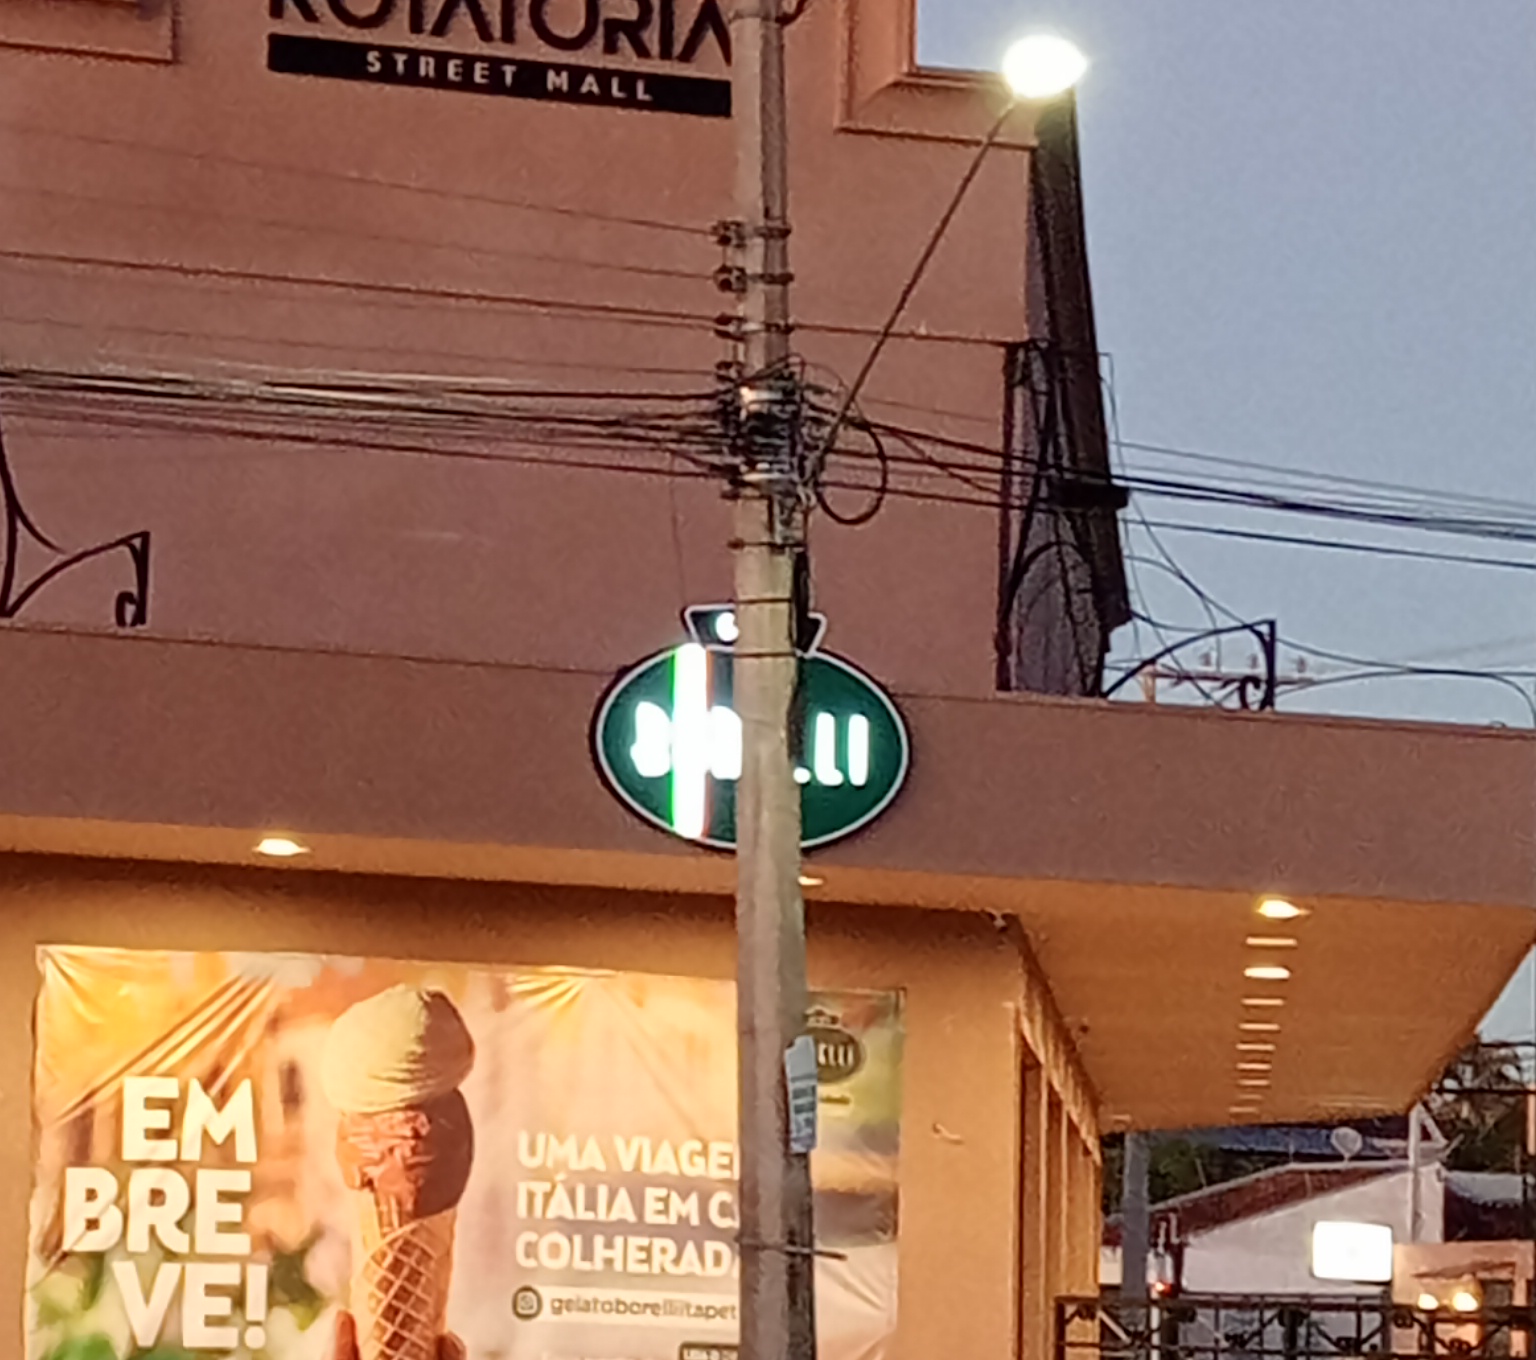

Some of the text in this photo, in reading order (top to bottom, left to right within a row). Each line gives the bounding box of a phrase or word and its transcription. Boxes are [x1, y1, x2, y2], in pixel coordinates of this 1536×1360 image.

[365, 50, 654, 102] STREET MALL
[120, 1075, 258, 1163] EM
[517, 1130, 607, 1172] UMA
[61, 1166, 252, 1256] BRE
[516, 1172, 638, 1223] ITÁLIA
[643, 1186, 701, 1227] EM
[515, 1230, 740, 1279] COLHERAD
[111, 1260, 269, 1350] VE!
